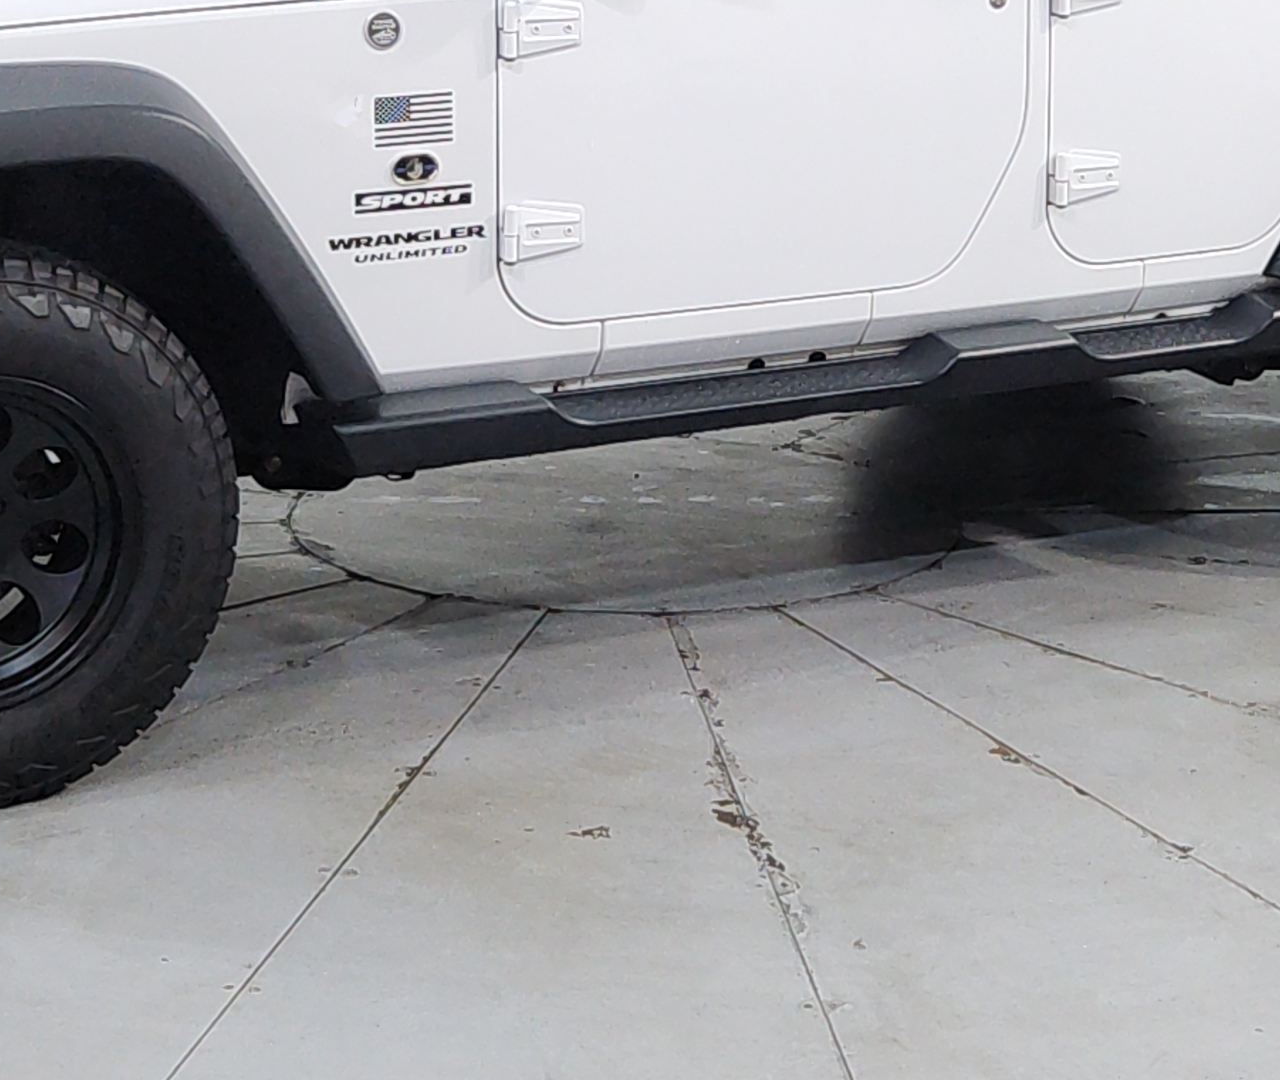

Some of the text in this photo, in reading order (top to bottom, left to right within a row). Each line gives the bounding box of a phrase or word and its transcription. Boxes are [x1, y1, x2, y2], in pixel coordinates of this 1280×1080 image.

[360, 189, 465, 210] SPORT
[329, 225, 486, 251] WRANGLER
[354, 245, 468, 263] UNLIMITED
